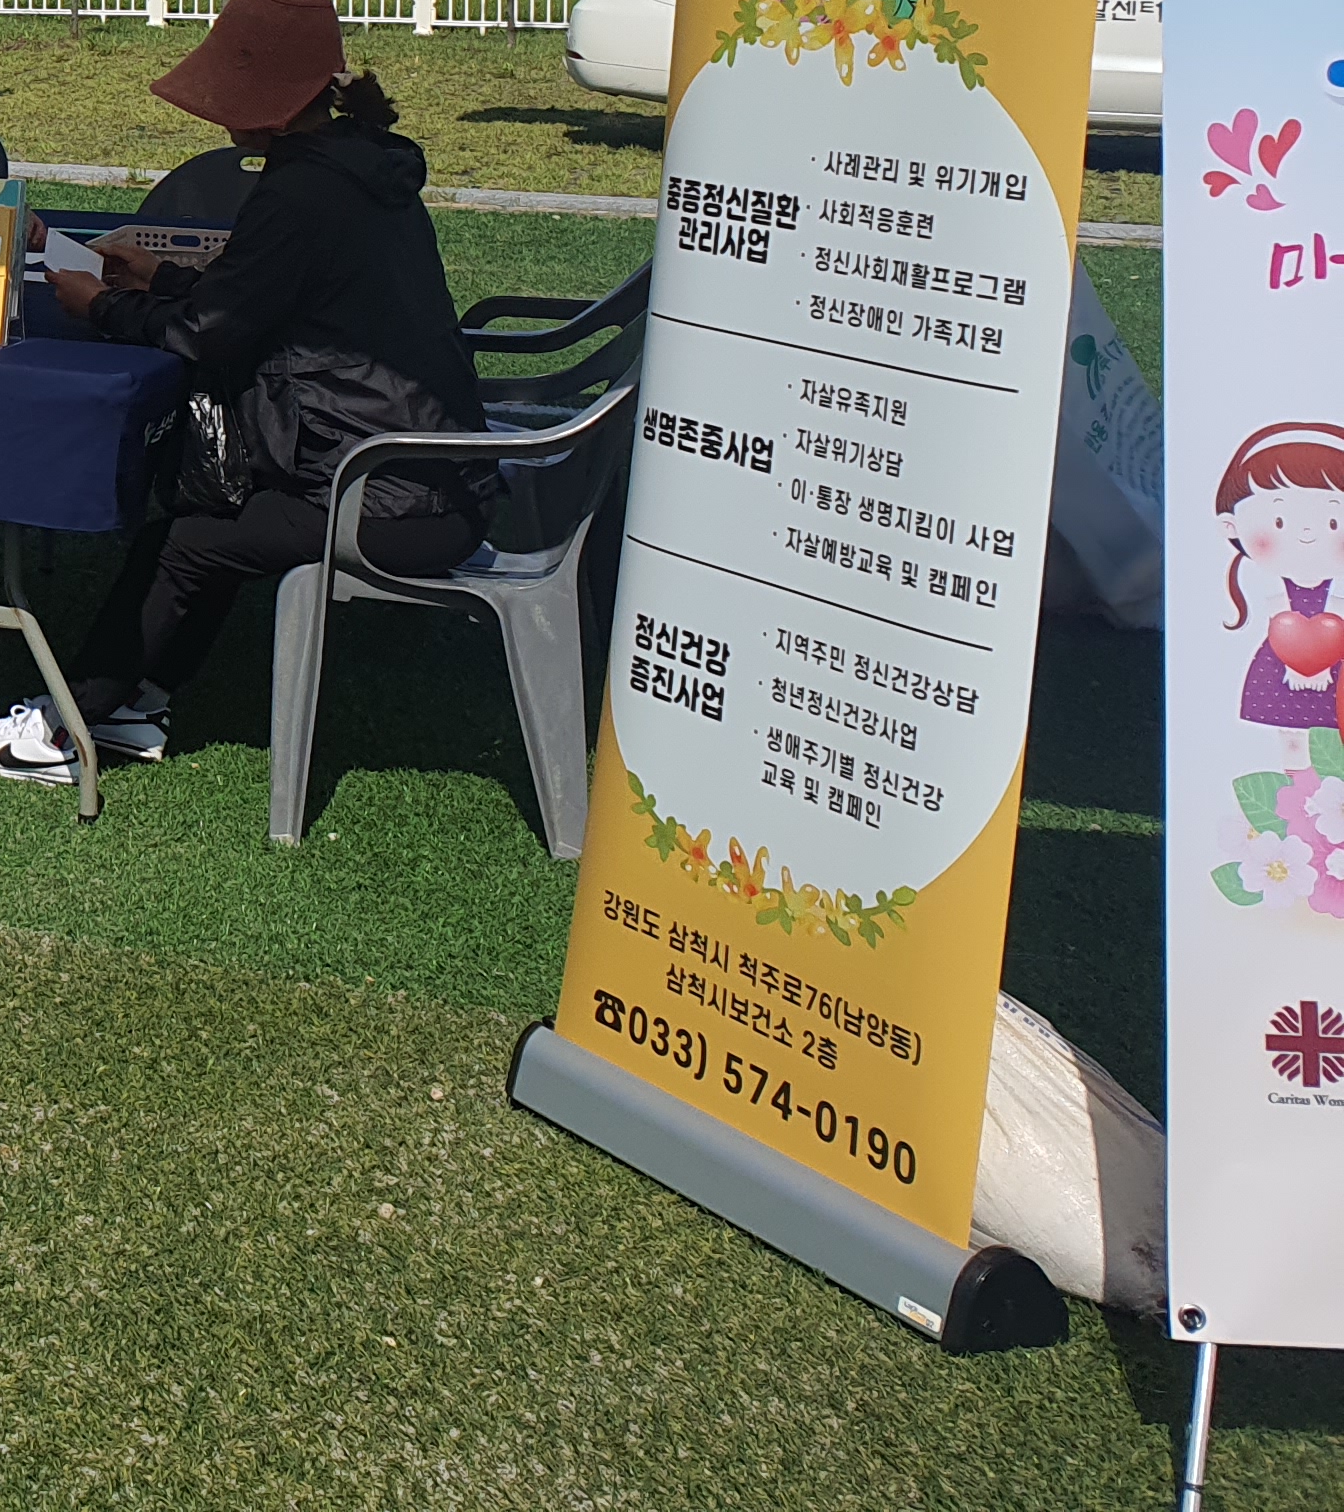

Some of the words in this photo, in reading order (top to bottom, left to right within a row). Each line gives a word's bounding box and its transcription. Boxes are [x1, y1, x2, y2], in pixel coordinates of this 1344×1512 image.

[665, 175, 801, 231] 중증정신질환
[823, 149, 899, 185] 사례관리
[907, 160, 926, 188] 및
[934, 165, 1029, 202] 위기개입
[677, 216, 771, 265] 관리사업
[818, 198, 936, 240] 사회적응훈련
[813, 246, 1028, 307] 정신사회재활프로그램
[808, 293, 904, 337] 정신장애인
[911, 313, 1004, 355] 가족지원
[799, 378, 909, 427] 자살유족지원
[642, 405, 775, 475] 생명존중사업
[794, 428, 904, 479] 자살위기상담
[857, 495, 956, 545] 생명지킴이
[965, 522, 1015, 558] 사업
[784, 527, 893, 582] 자살예방교육
[900, 560, 919, 589] 및
[927, 566, 998, 610] 캠페인
[635, 612, 731, 677] 정신건강
[775, 627, 846, 674] 지역주민
[853, 652, 980, 715] 정신건강상담
[629, 654, 726, 723] 증진사업
[770, 675, 919, 752] 청년정신건강사업
[760, 759, 796, 796] 교육
[803, 776, 820, 805] 및
[827, 785, 883, 830] 캠페인
[766, 724, 856, 782] 생애주기별
[862, 761, 945, 813] 정신건강
[602, 889, 661, 940] 강원도
[667, 919, 730, 974] 삼척시
[737, 950, 923, 1067] 척주로76(남양동)
[665, 962, 794, 1049] 삼척시보건소
[801, 1029, 839, 1071] 2층
[722, 1050, 918, 1186] 574-0190
[1267, 1092, 1311, 1106] Caritas
